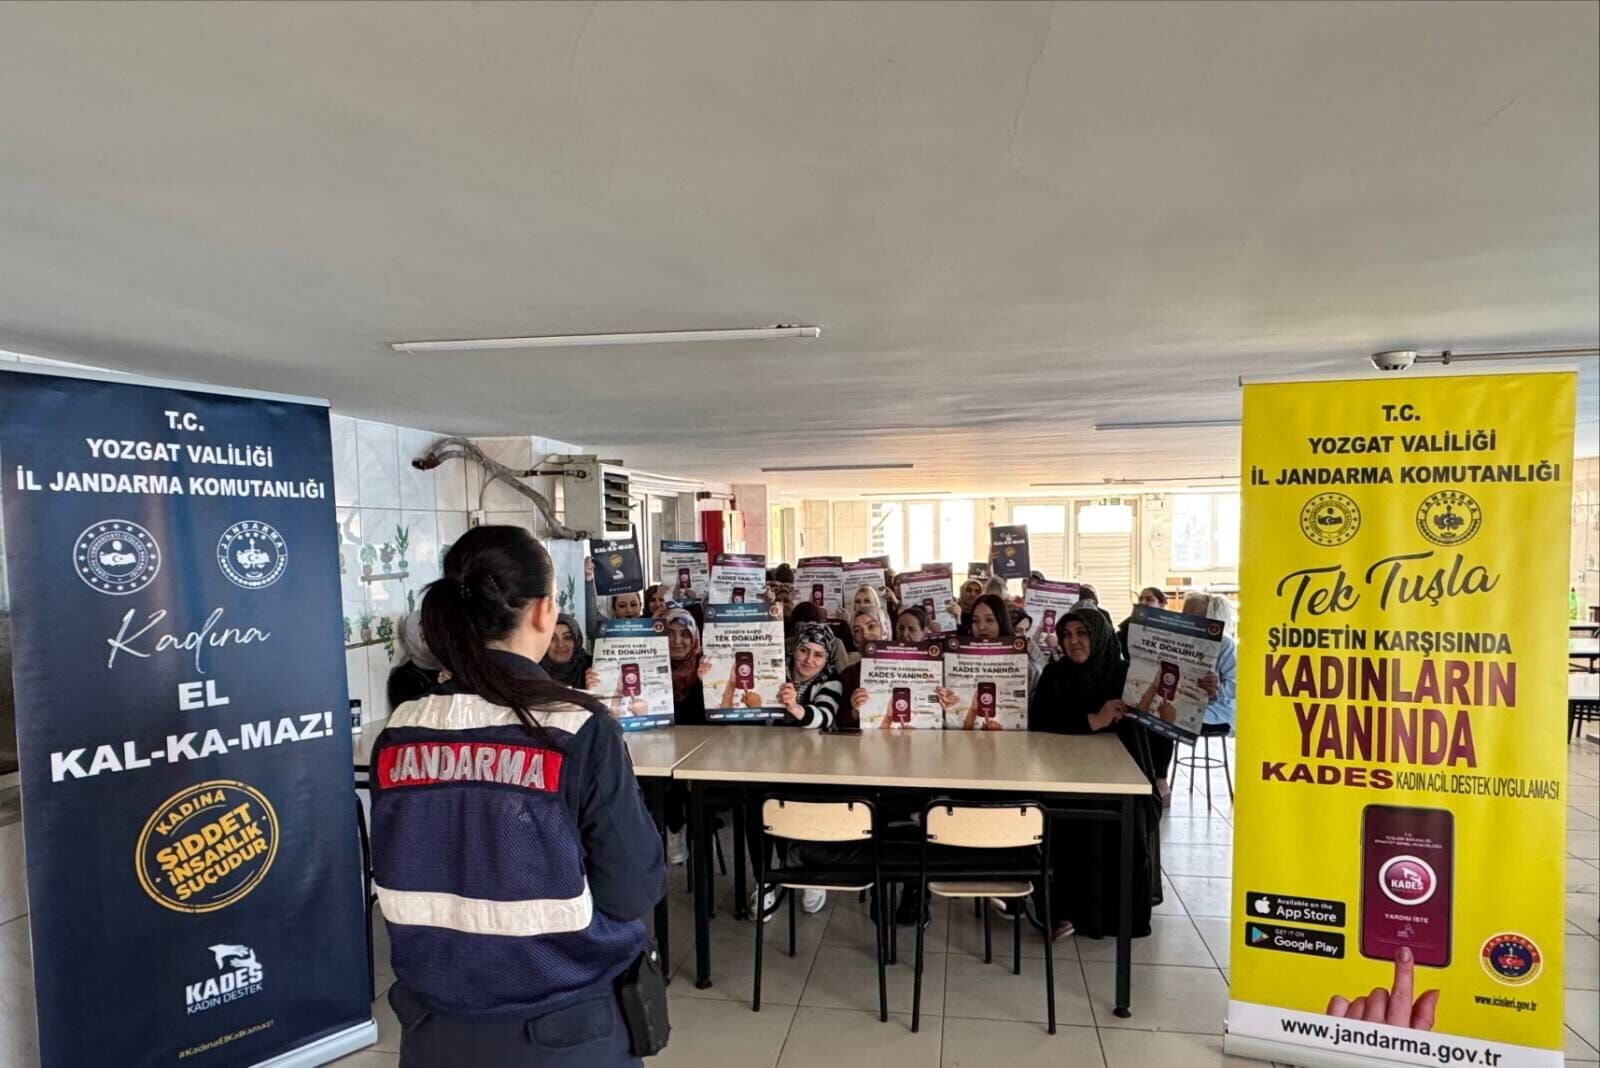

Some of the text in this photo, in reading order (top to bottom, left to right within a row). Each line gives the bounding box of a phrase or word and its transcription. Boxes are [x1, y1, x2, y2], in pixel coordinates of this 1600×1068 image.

[164, 410, 205, 431] T.C.
[1382, 404, 1421, 422] T.C.
[86, 438, 274, 467] YOZGAT VALİLİĞİ
[1308, 429, 1497, 454] YOZGAT VALİLİĞİ
[16, 465, 325, 499] İL JANDARMA KOMUTANLIĞI
[1251, 460, 1560, 485] İL JANDARMA KOMUTANLIĞI
[1421, 491, 1478, 515] JANDARMA
[221, 523, 283, 550] JANDARMA
[1276, 550, 1501, 623] Tek Tuşla
[107, 607, 271, 674] Kadına
[1268, 623, 1512, 658] ŞİDDETİN KARŞISINDA
[868, 671, 935, 680] KADES YANINDA
[1264, 653, 1517, 708] KADINLARIN
[178, 679, 230, 711] EL
[50, 711, 335, 783] KAL-KA-MAZ!
[1293, 702, 1478, 768] YANINDA
[389, 745, 546, 789] JANDARMA
[1262, 761, 1560, 800] KADES KADIN ACİL DESTEK UYGULAMASI
[155, 789, 226, 836] KADINA
[1391, 878, 1425, 891] KADES
[1276, 898, 1309, 908] Available
[1320, 902, 1333, 910] the
[1276, 905, 1337, 922] App Store
[1384, 913, 1412, 922] YARDIM
[1273, 936, 1339, 955] Google Play
[185, 966, 264, 1006] KADES
[187, 982, 264, 1015] KADIN DESTEK
[1281, 1016, 1502, 1067] www.jandarma.gov.tr
